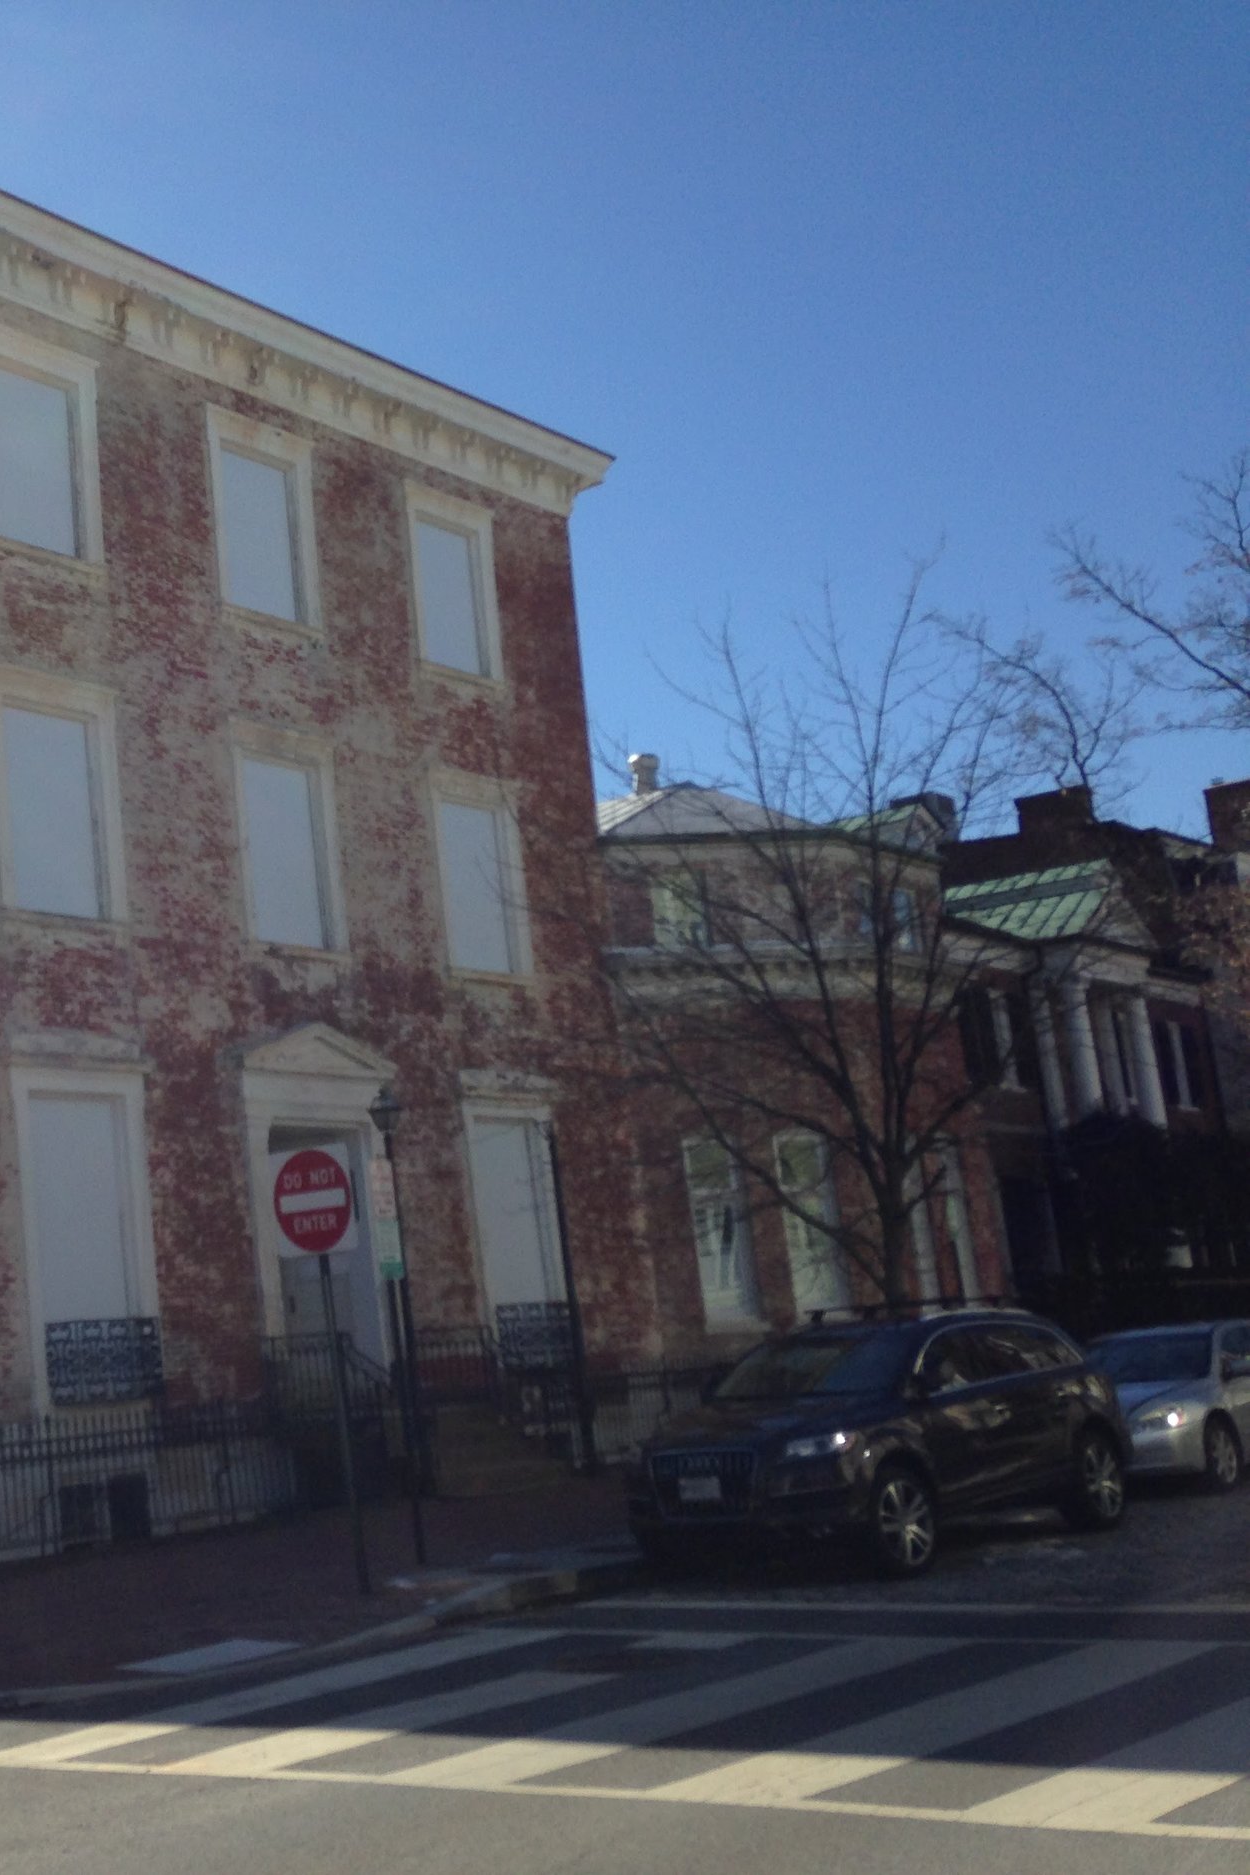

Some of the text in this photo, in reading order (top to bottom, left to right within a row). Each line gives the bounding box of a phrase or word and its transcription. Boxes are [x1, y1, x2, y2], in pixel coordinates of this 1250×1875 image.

[282, 1167, 336, 1190] DO NOT
[293, 1213, 337, 1235] ENTER
